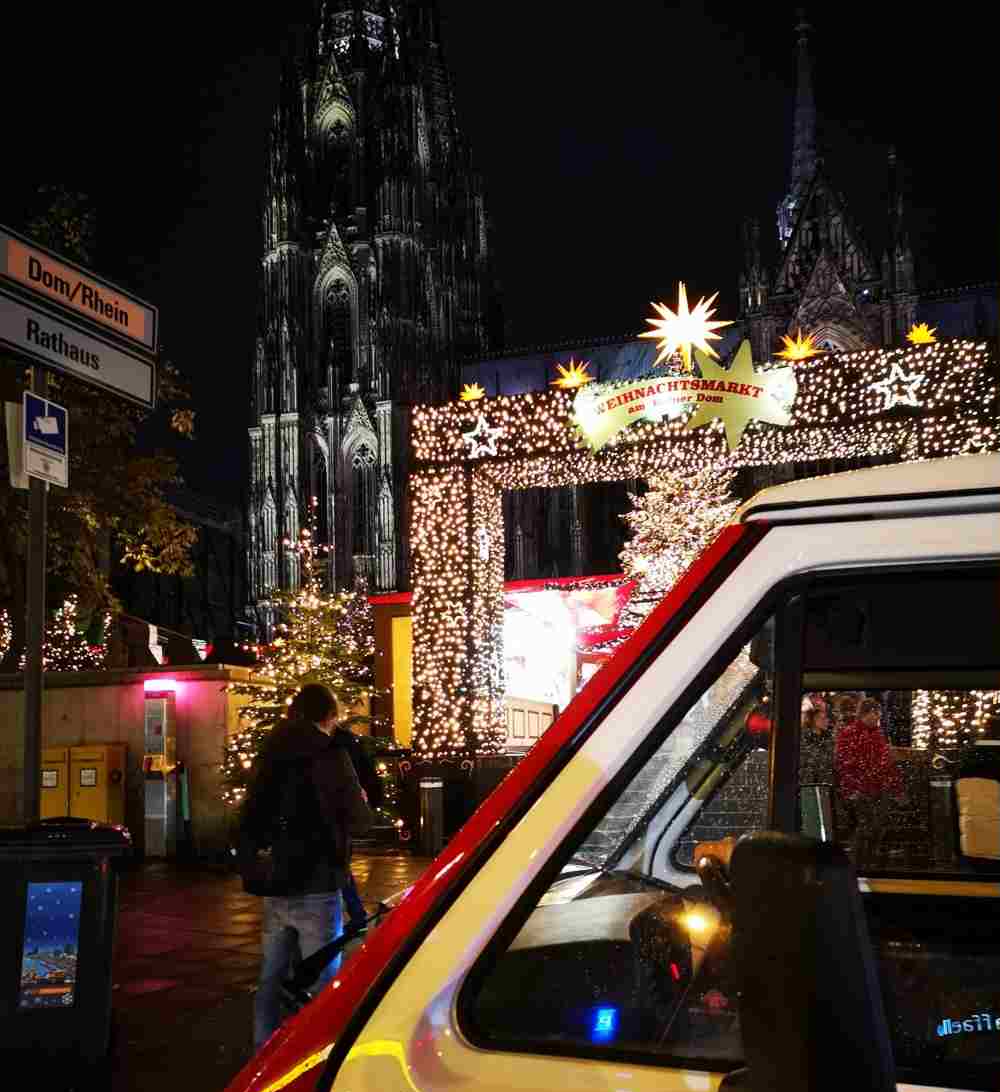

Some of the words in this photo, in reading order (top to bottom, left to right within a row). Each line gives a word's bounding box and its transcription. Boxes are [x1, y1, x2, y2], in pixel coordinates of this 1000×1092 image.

[28, 255, 128, 327] Dom/Rhein
[26, 318, 100, 370] Rathaus
[696, 393, 724, 403] Dom
